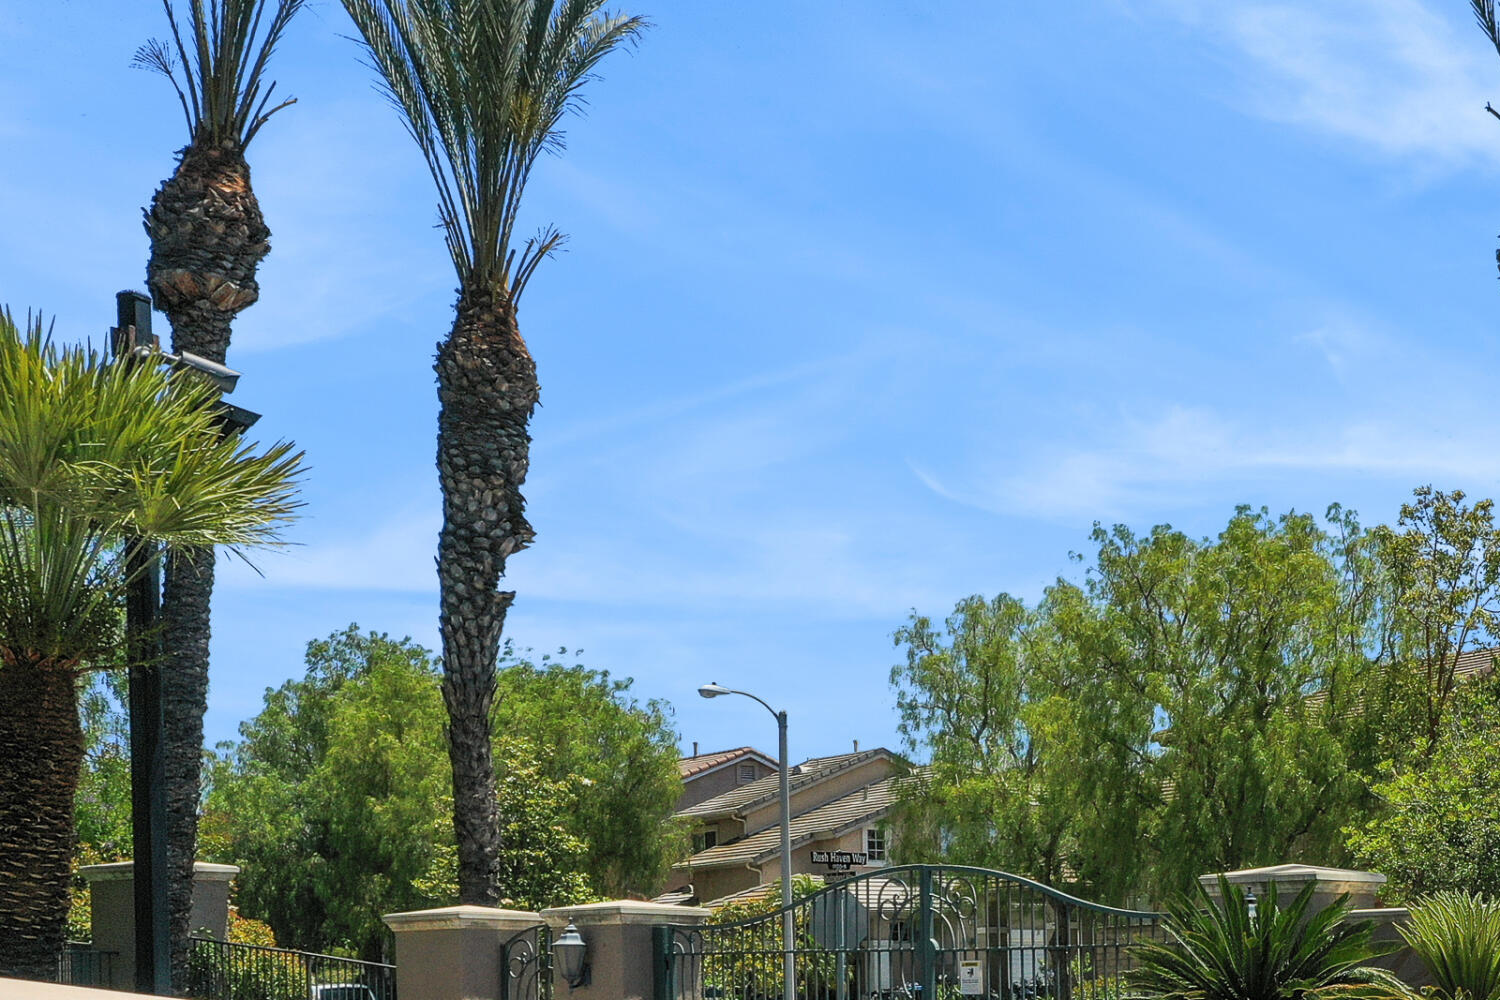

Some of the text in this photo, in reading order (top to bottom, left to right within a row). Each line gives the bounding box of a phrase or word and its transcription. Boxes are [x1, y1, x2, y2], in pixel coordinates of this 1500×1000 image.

[813, 852, 866, 864] Rush Haven Way
